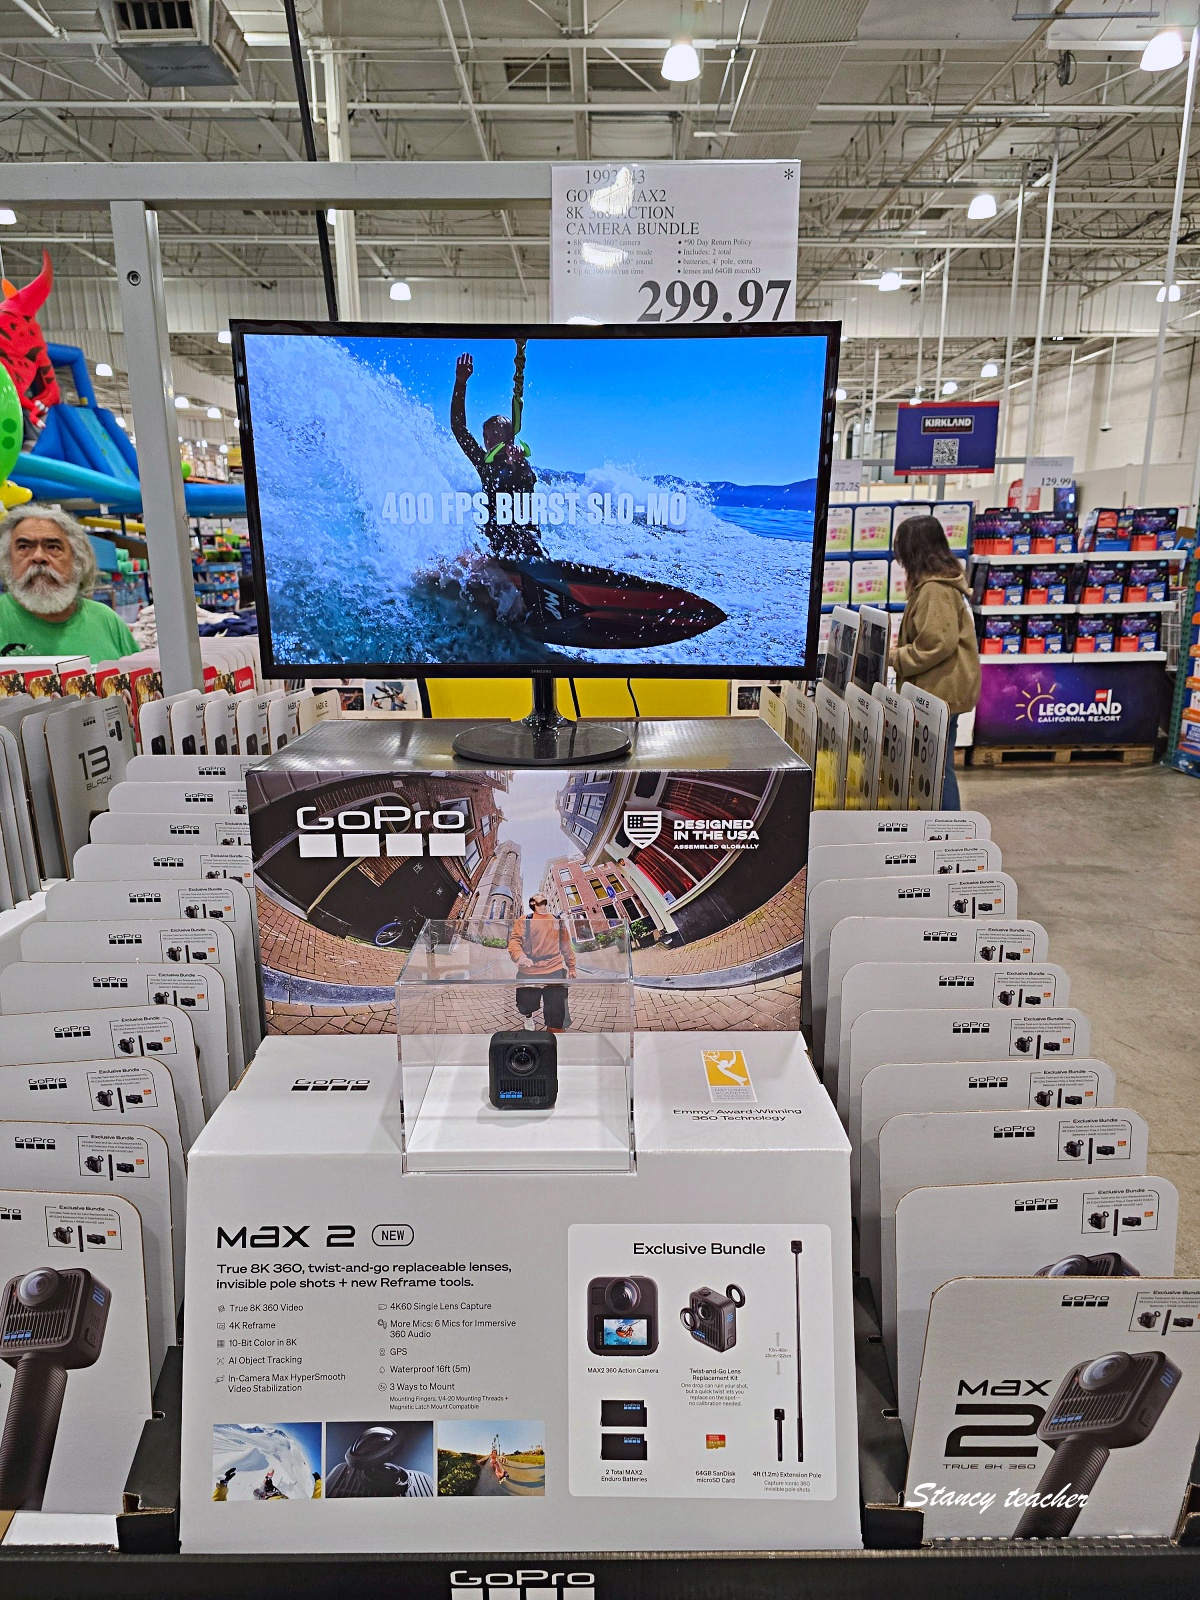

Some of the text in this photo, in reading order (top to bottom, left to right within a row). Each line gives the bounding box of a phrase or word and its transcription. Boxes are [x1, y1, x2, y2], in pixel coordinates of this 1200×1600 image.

[566, 206, 584, 219] 8K
[566, 222, 700, 235] CAMERA BUNDLE
[697, 239, 709, 247] Day
[733, 239, 752, 247] Policy
[636, 280, 792, 322] 299.97
[925, 418, 971, 427] KIRKLAND
[834, 482, 860, 491] 77.75
[1041, 477, 1072, 487] 129.99
[381, 492, 687, 526] 400 FPS BURST SLO-MO
[1039, 689, 1122, 716] LEGOLAND
[78, 744, 111, 780] 13
[86, 774, 112, 791] BLACK
[674, 820, 754, 830] DESIGNED
[674, 831, 760, 840] IN THE USA
[326, 1225, 356, 1247] 2
[381, 1230, 405, 1241] NEW
[634, 1243, 765, 1255] Exclusive Bundle
[217, 1262, 511, 1274] True 8K 360, twist-and-go replaceable lenses,
[217, 1279, 267, 1289] invisible
[270, 1278, 296, 1290] pole
[299, 1278, 335, 1288] shots
[339, 1278, 347, 1287] +
[381, 1277, 436, 1287] Reframe
[439, 1277, 474, 1287] tools.
[262, 1304, 279, 1312] 360
[390, 1302, 412, 1310] 4K60
[413, 1302, 438, 1312] Single
[460, 1302, 492, 1311] Capture
[390, 1330, 406, 1338] 360
[254, 1339, 275, 1347] Color
[390, 1348, 407, 1356] GPS
[239, 1356, 265, 1366] Object
[267, 1356, 302, 1365] Tracking
[390, 1365, 471, 1374] Waterproof 16ft (5m)
[229, 1374, 270, 1382] In-Camera
[291, 1373, 346, 1382] HyperSmooth
[253, 1384, 302, 1392] Stabilization
[397, 1383, 418, 1392] Ways
[430, 1382, 455, 1390] Mount
[944, 1404, 1046, 1457] 2
